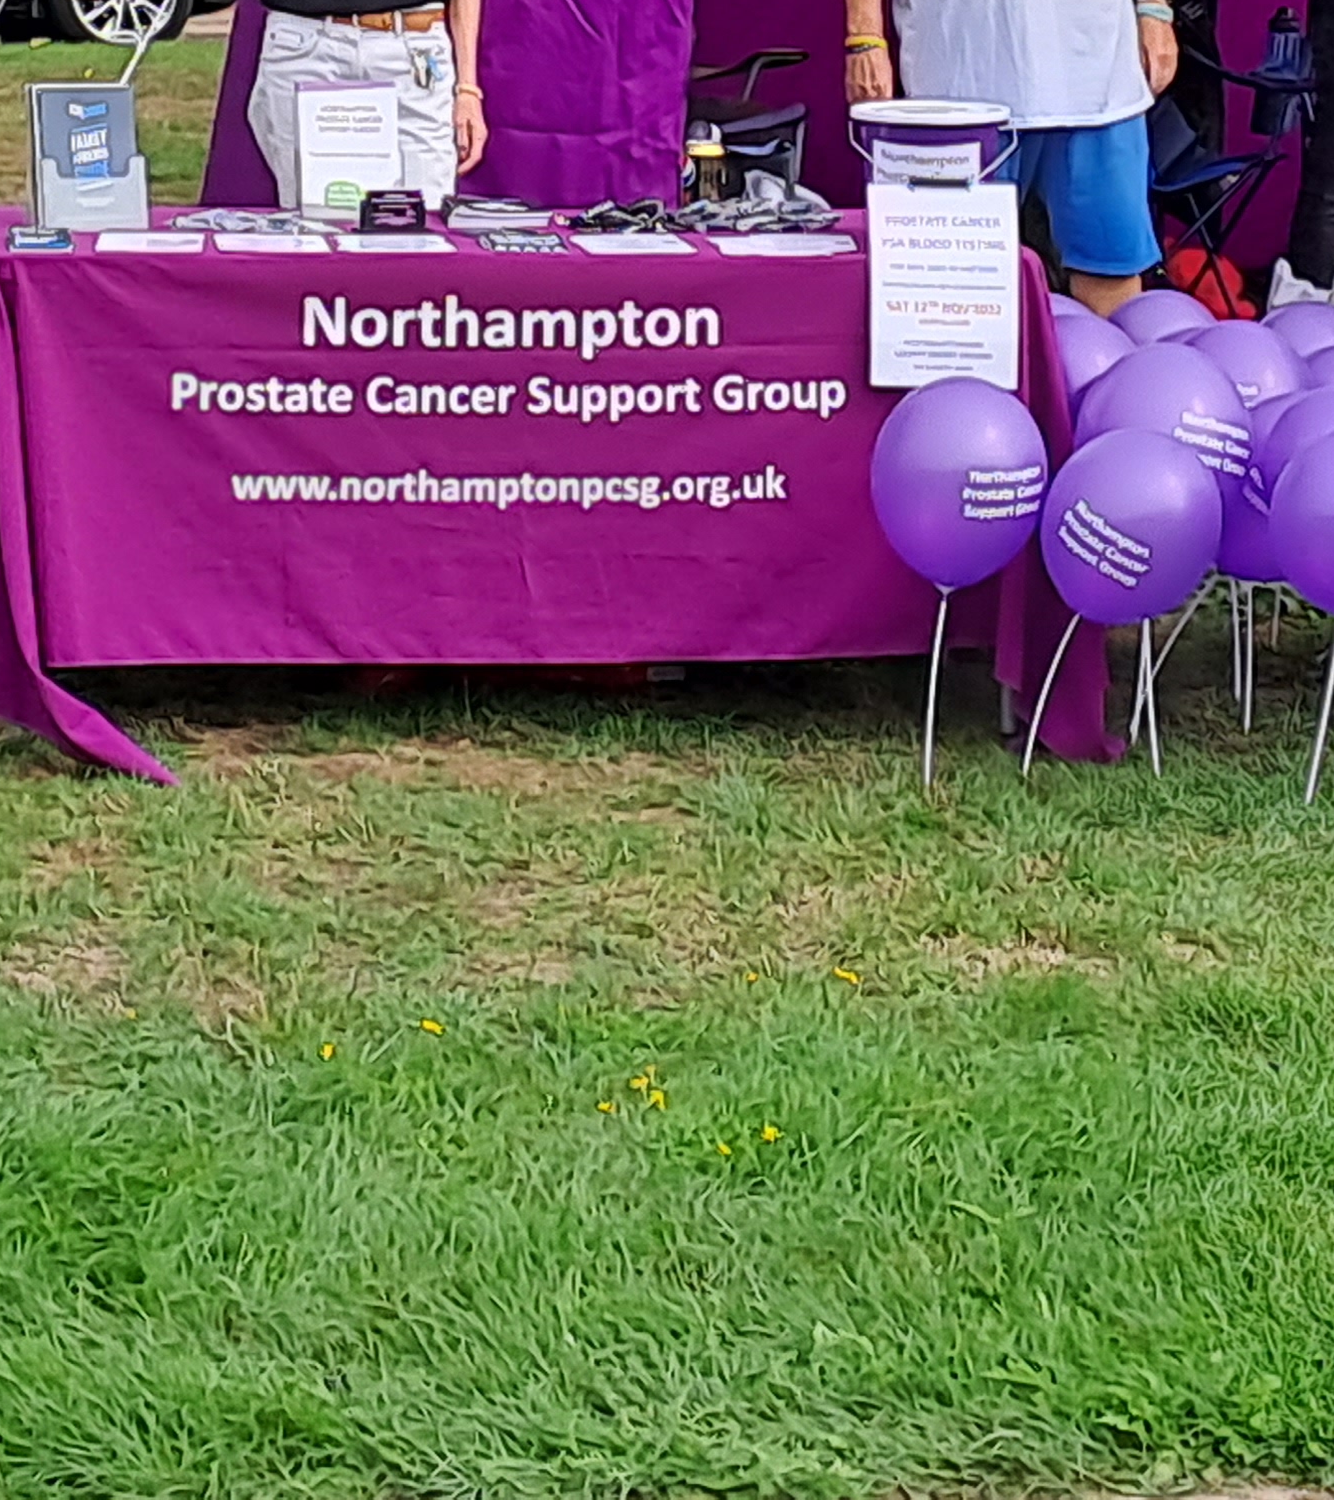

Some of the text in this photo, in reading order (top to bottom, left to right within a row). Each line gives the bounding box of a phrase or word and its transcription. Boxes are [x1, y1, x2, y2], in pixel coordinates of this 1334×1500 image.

[884, 216, 1001, 228] PROSTATE CANCER
[909, 238, 951, 250] BLOOD
[302, 294, 720, 360] Northampton
[886, 300, 909, 313] SAT
[171, 372, 847, 423] Prostate Cancer Support Group
[231, 465, 788, 511] www.northamptonpcsg.org.uk
[1075, 499, 1150, 558] Northampton
